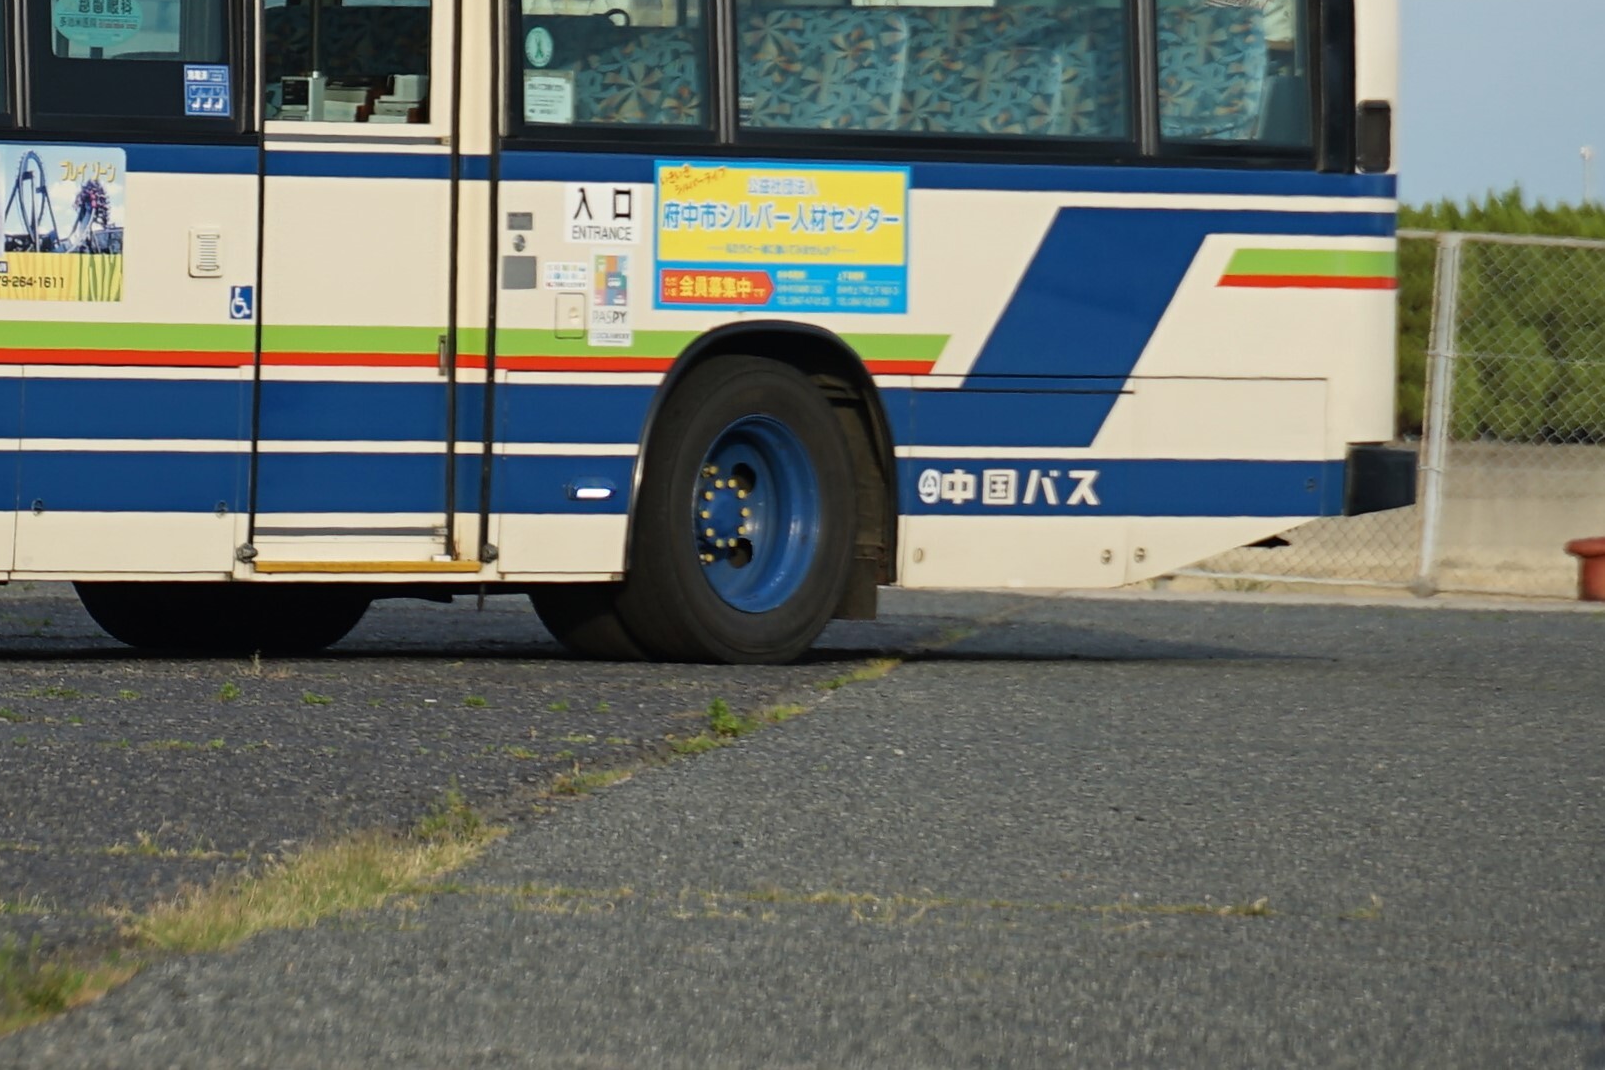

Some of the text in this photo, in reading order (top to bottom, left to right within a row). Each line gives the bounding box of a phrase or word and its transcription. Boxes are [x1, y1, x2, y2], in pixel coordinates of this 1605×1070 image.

[573, 187, 632, 220] 入口
[662, 202, 899, 232] 府中市シルバー人材センター
[571, 225, 632, 241] ENTRANCE
[592, 310, 627, 324] PASPY
[941, 469, 1101, 505] 中国バス
